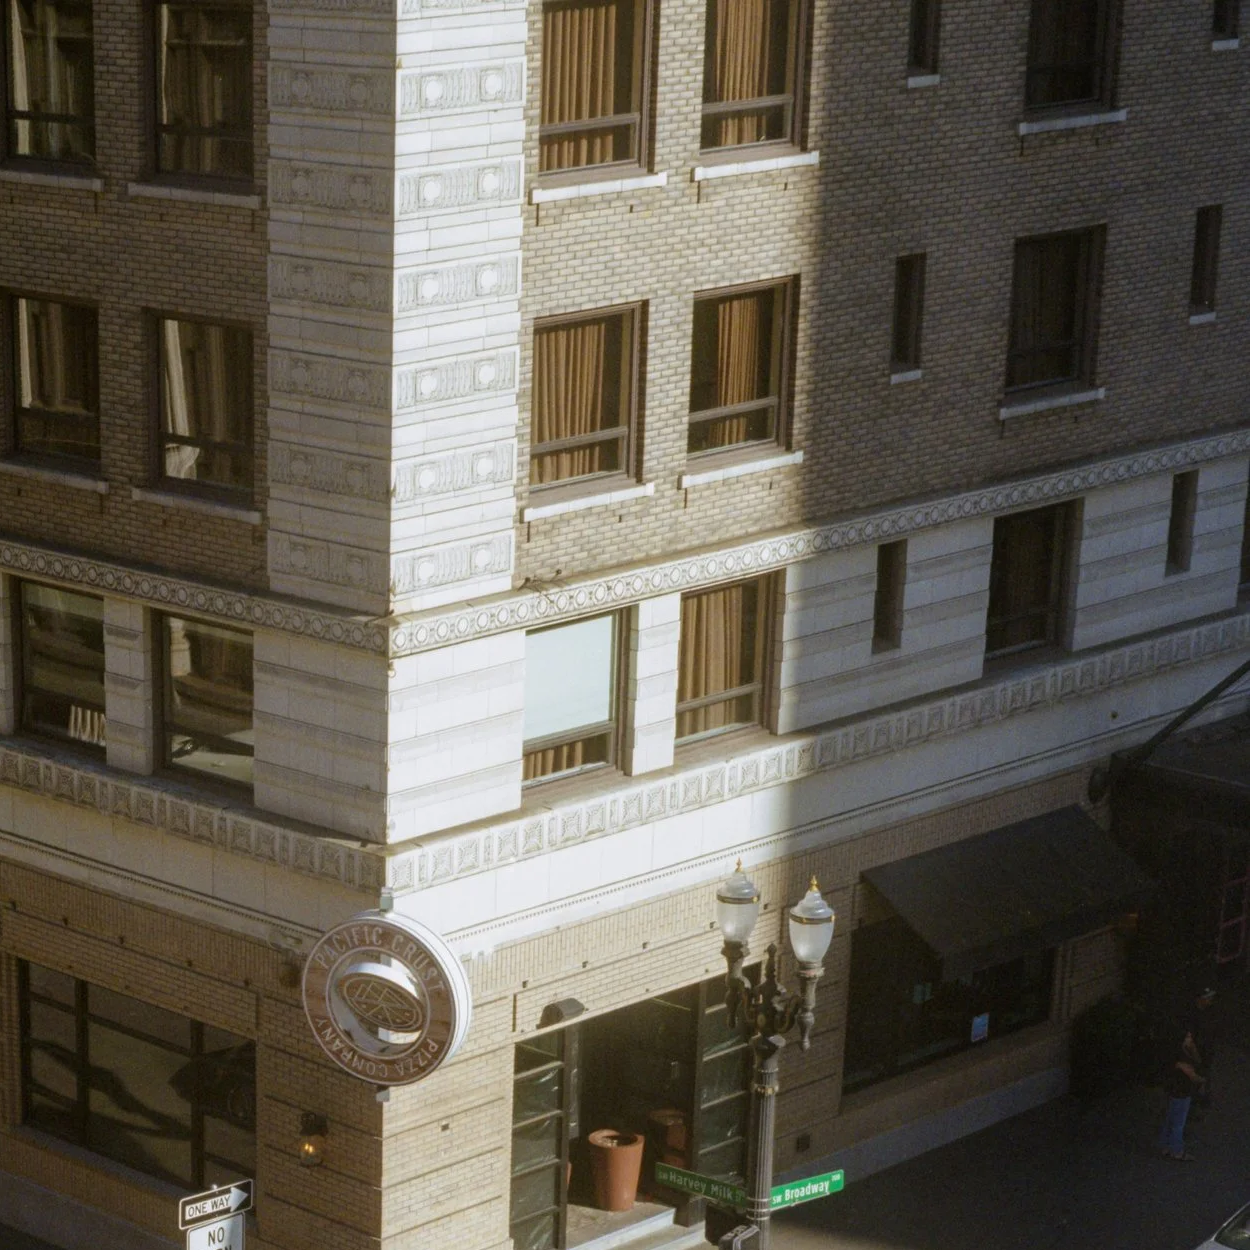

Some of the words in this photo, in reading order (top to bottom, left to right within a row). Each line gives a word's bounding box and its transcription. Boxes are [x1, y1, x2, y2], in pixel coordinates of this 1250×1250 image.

[315, 926, 383, 969] PACIFIC
[391, 934, 445, 992] CRUST
[317, 1018, 389, 1078] COMPANY
[395, 1037, 439, 1077] PIZZA
[670, 1172, 707, 1194] Harvey
[711, 1184, 733, 1201] Milk
[772, 1195, 782, 1205] SW
[785, 1180, 830, 1201] Broadway
[188, 1200, 208, 1218] ONE
[211, 1194, 230, 1213] WAY
[208, 1226, 225, 1247] NO
